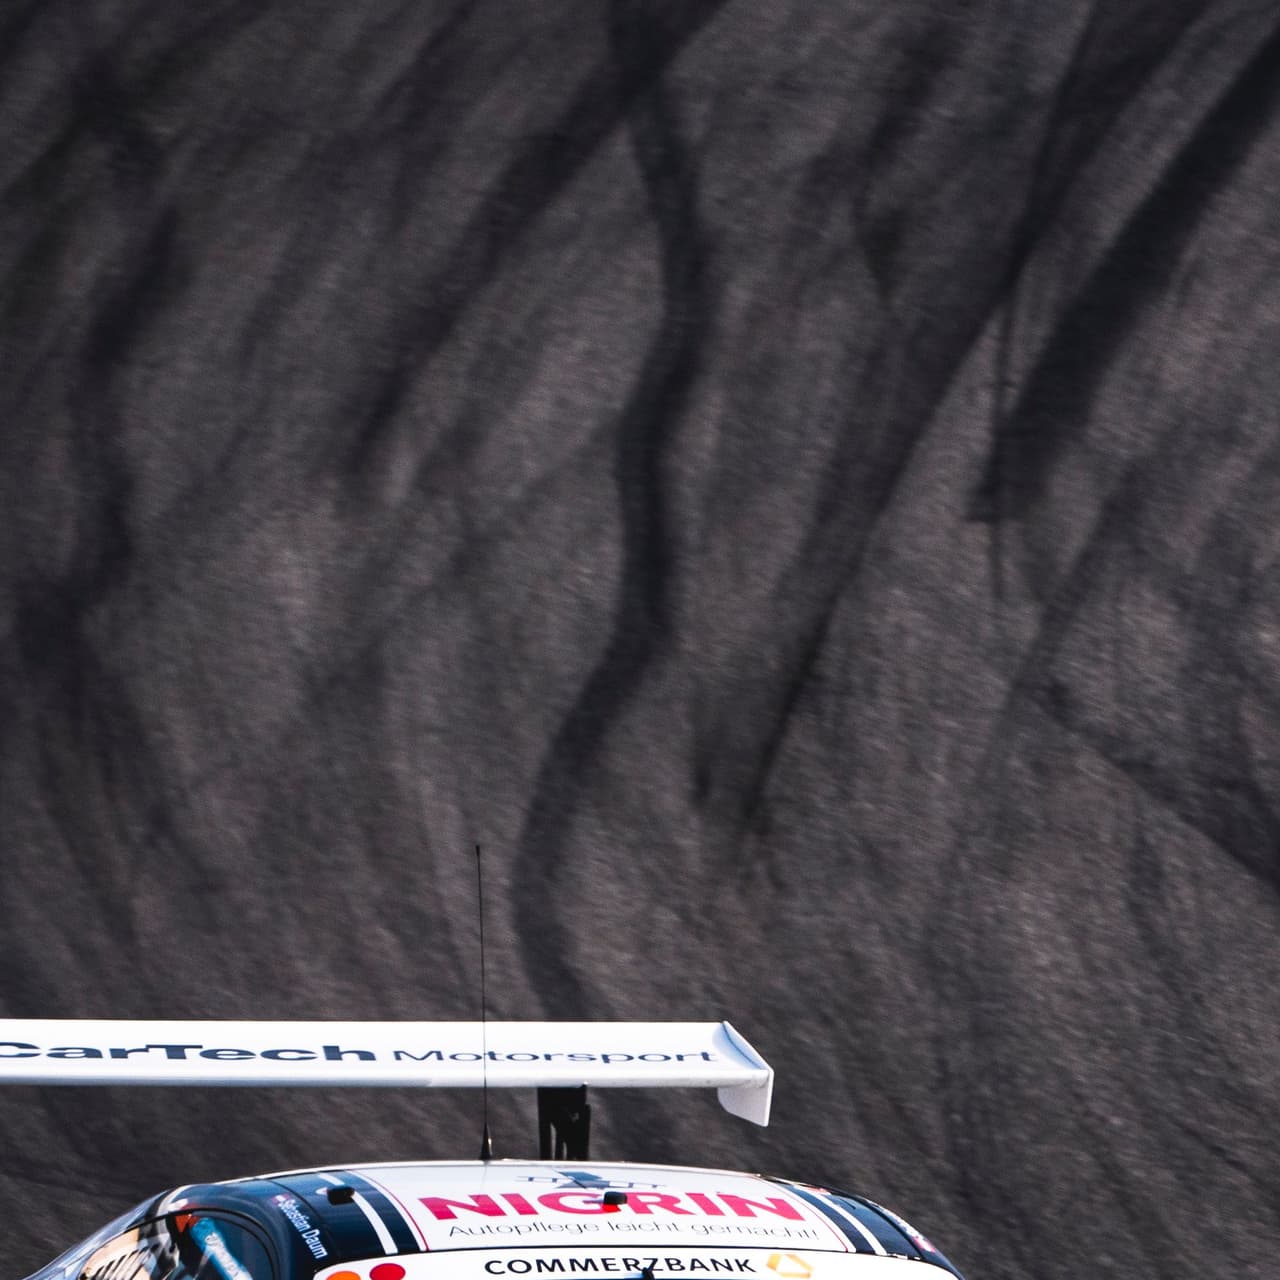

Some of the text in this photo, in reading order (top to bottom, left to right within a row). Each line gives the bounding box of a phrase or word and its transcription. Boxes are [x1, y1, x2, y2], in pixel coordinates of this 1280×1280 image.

[393, 1049, 718, 1064] Motorsport
[418, 1191, 806, 1221] NIGRIN
[449, 1219, 819, 1241] Autopflege leicht gemacht!
[302, 1228, 328, 1259] Daum
[484, 1257, 756, 1275] COMMERZBANK
